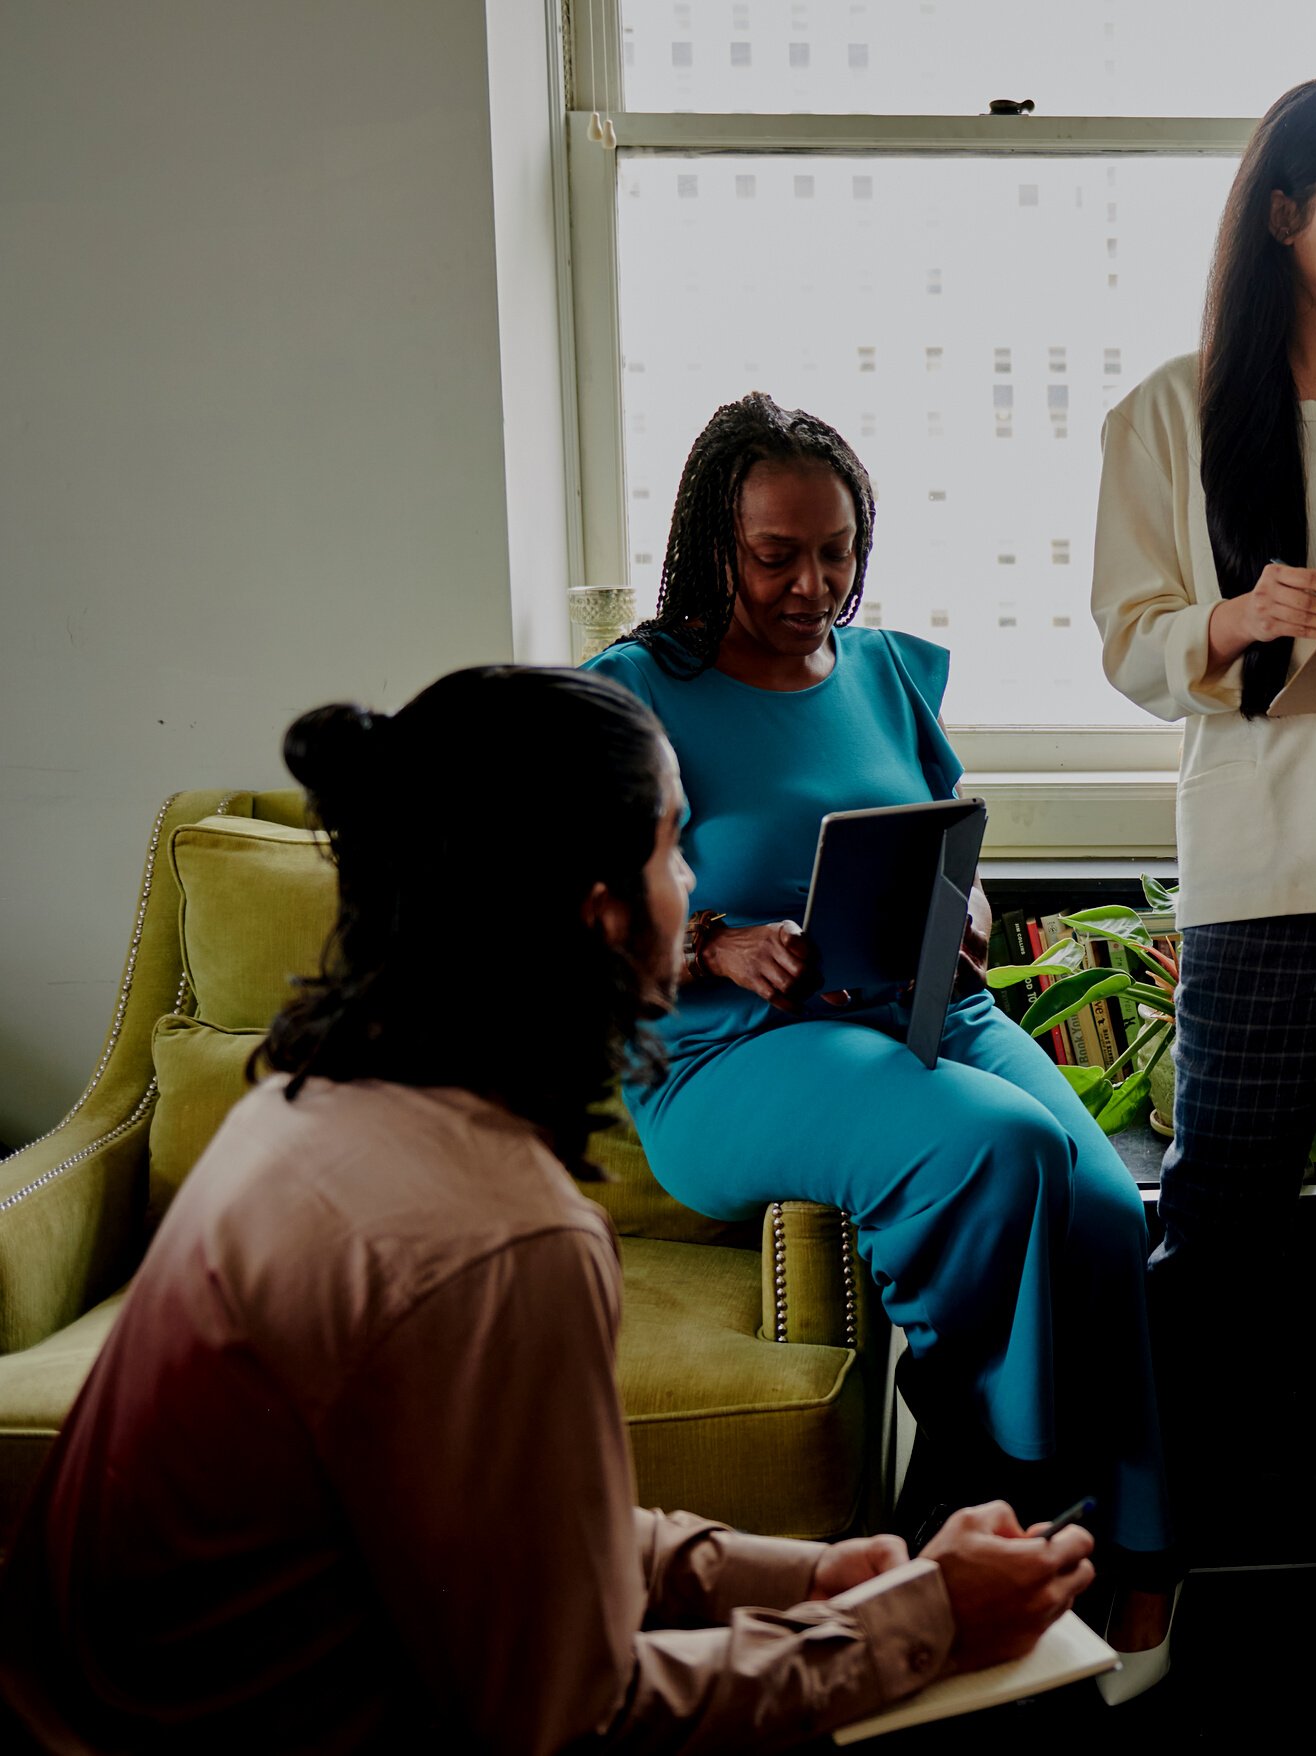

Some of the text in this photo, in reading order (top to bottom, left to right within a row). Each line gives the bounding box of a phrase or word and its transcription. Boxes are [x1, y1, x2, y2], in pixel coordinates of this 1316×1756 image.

[1016, 933, 1025, 955] COLLINS
[1025, 978, 1033, 991] OD
[1094, 1000, 1103, 1015] ve
[1071, 1014, 1088, 1064] Book You
